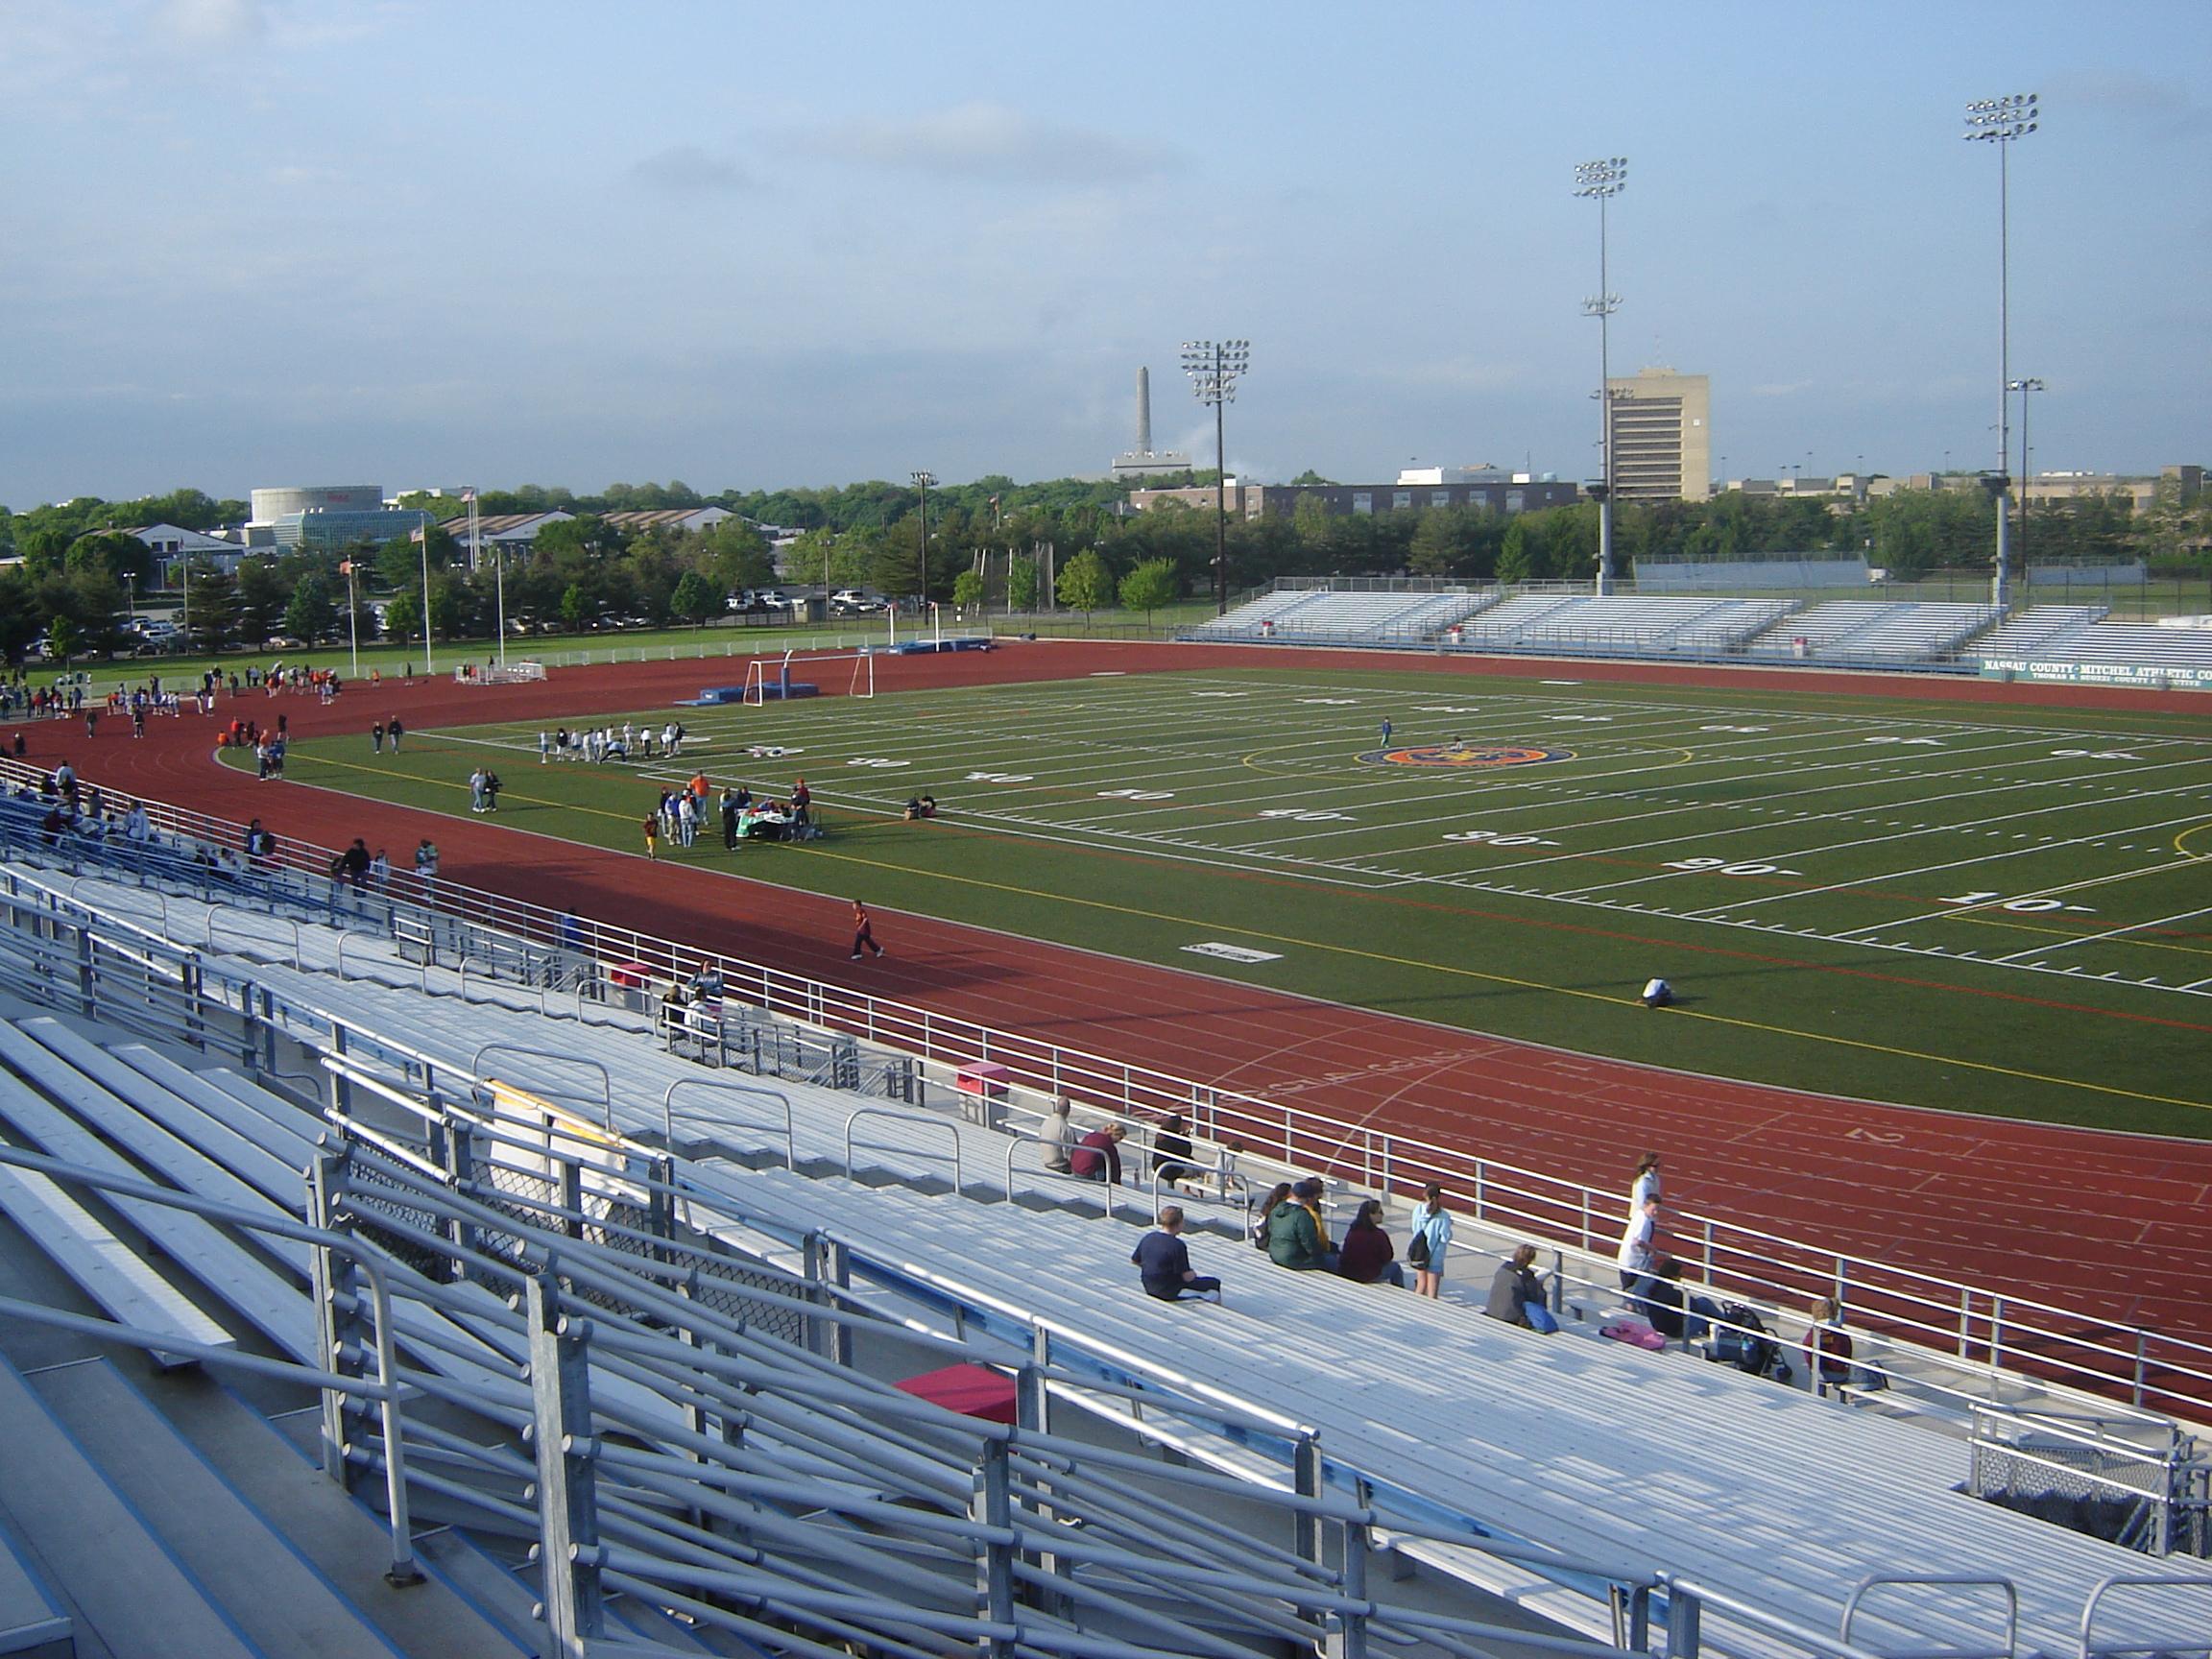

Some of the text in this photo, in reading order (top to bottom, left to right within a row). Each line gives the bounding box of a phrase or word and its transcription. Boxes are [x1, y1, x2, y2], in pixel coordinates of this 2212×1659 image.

[1984, 660, 2027, 671] NASSAU
[1662, 857, 1777, 876] 20
[1937, 891, 2062, 912] 10
